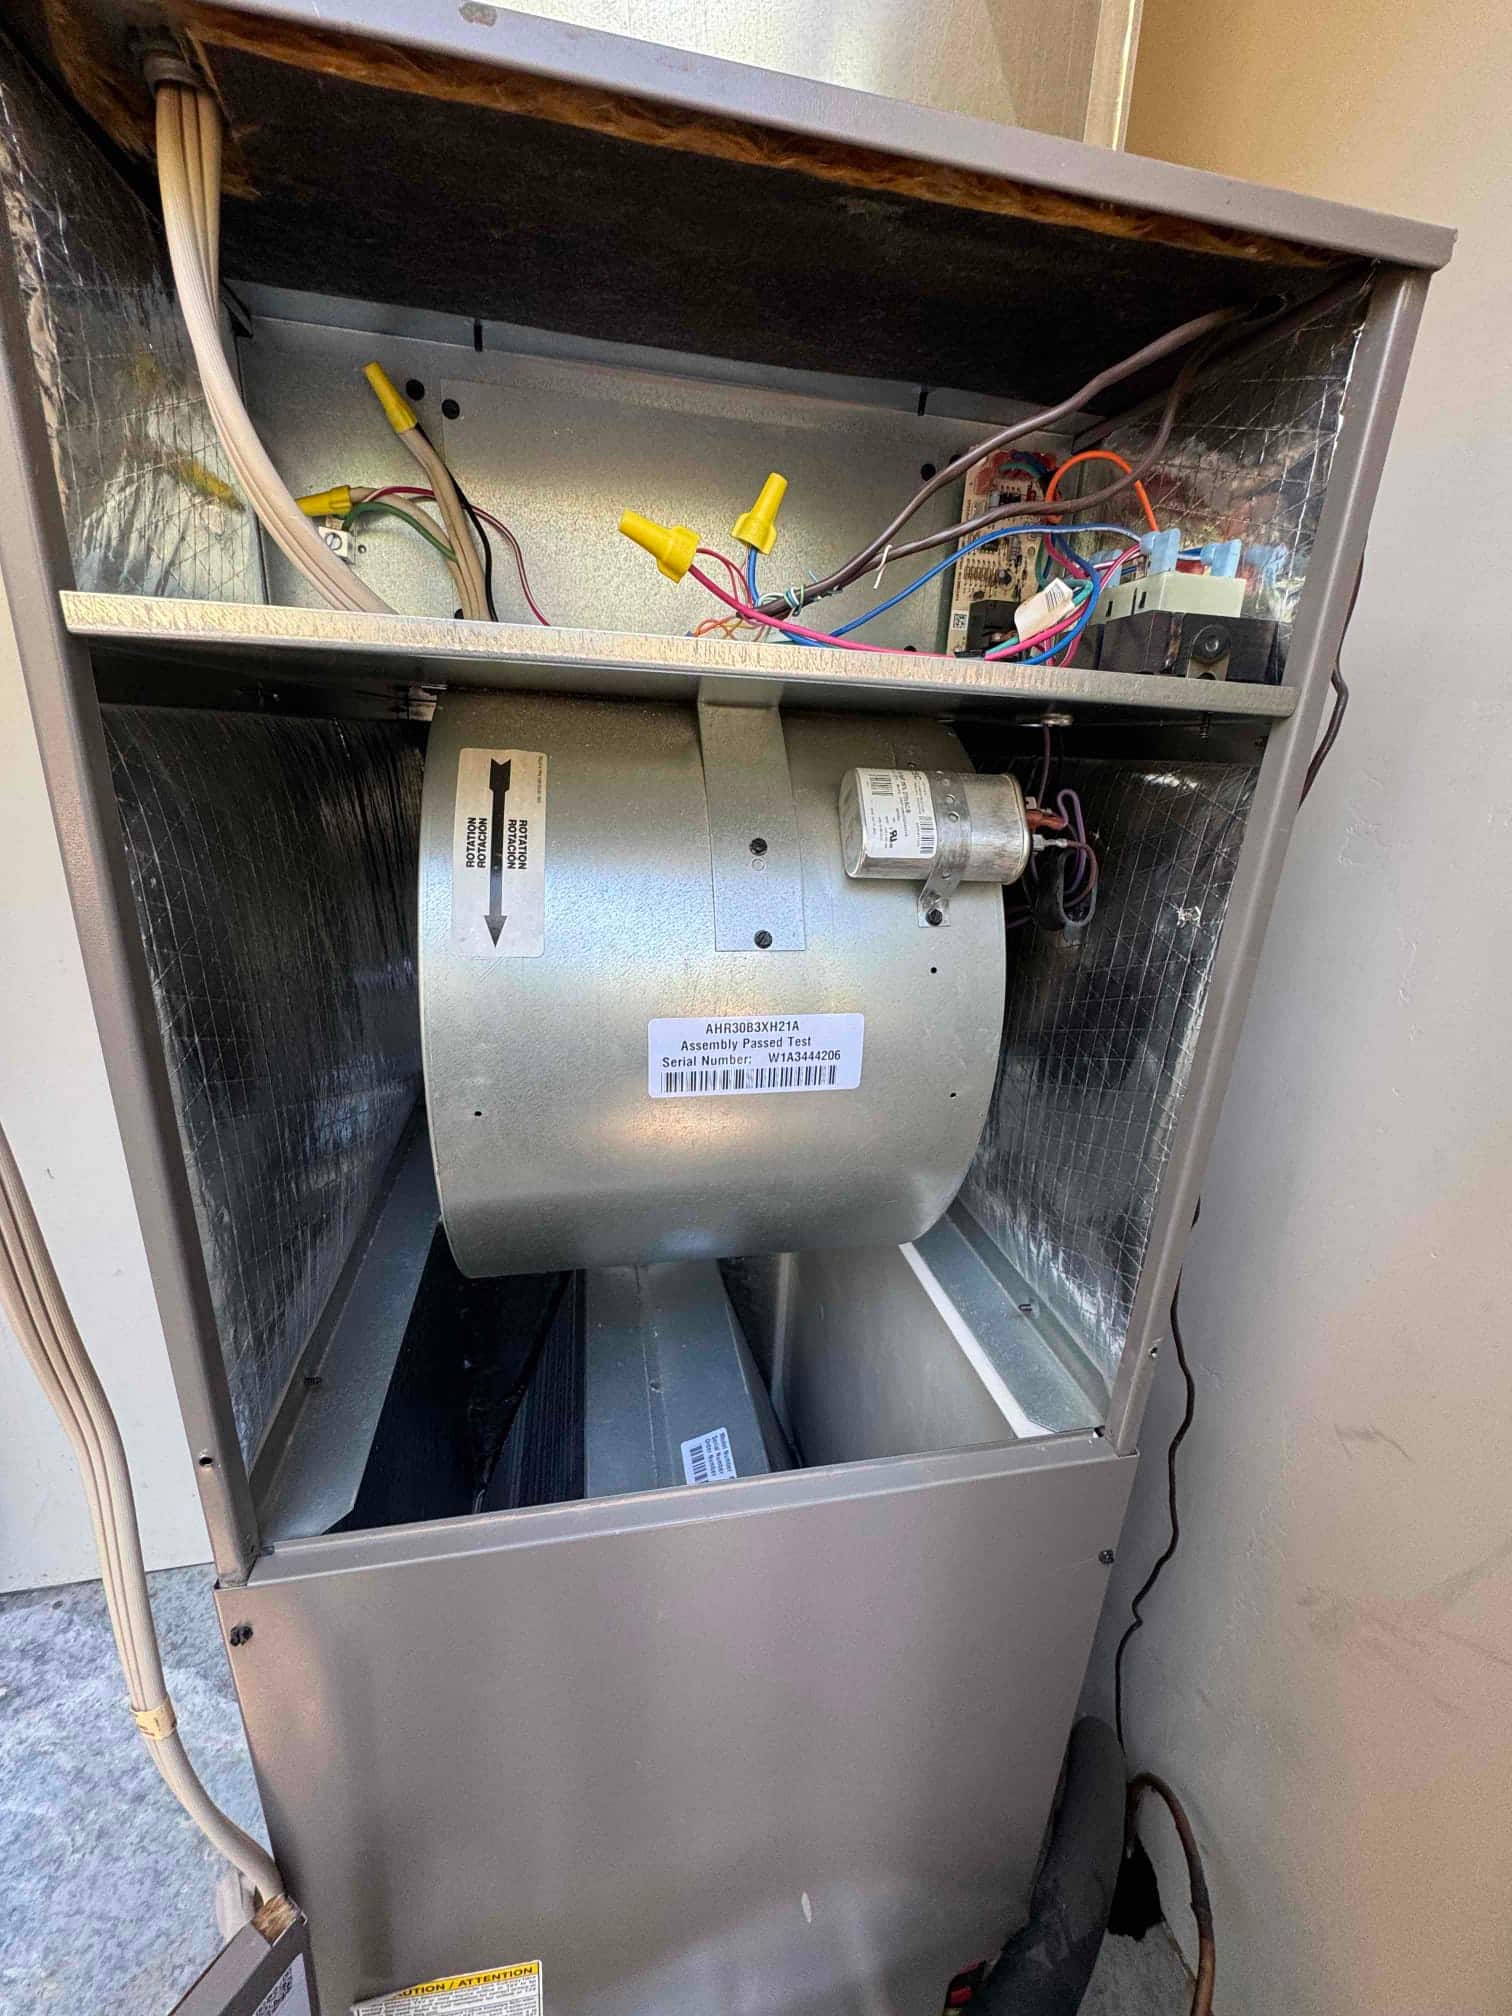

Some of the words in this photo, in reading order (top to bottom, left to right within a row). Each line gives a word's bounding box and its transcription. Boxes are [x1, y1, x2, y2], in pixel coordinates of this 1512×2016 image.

[466, 817, 476, 868] ROTATION
[477, 817, 488, 868] ROTACION
[507, 819, 517, 869] ROTACION
[518, 819, 528, 869] ROTATION
[681, 1038, 738, 1051] Assembly
[742, 1037, 783, 1049] Passed
[787, 1036, 811, 1047] Test
[705, 1021, 800, 1034] AHR30B3XH21A
[662, 1056, 697, 1068] Serial
[701, 1054, 752, 1066] Number:
[768, 1050, 841, 1063] W1A3444206
[458, 1967, 533, 1987] ATTENTION
